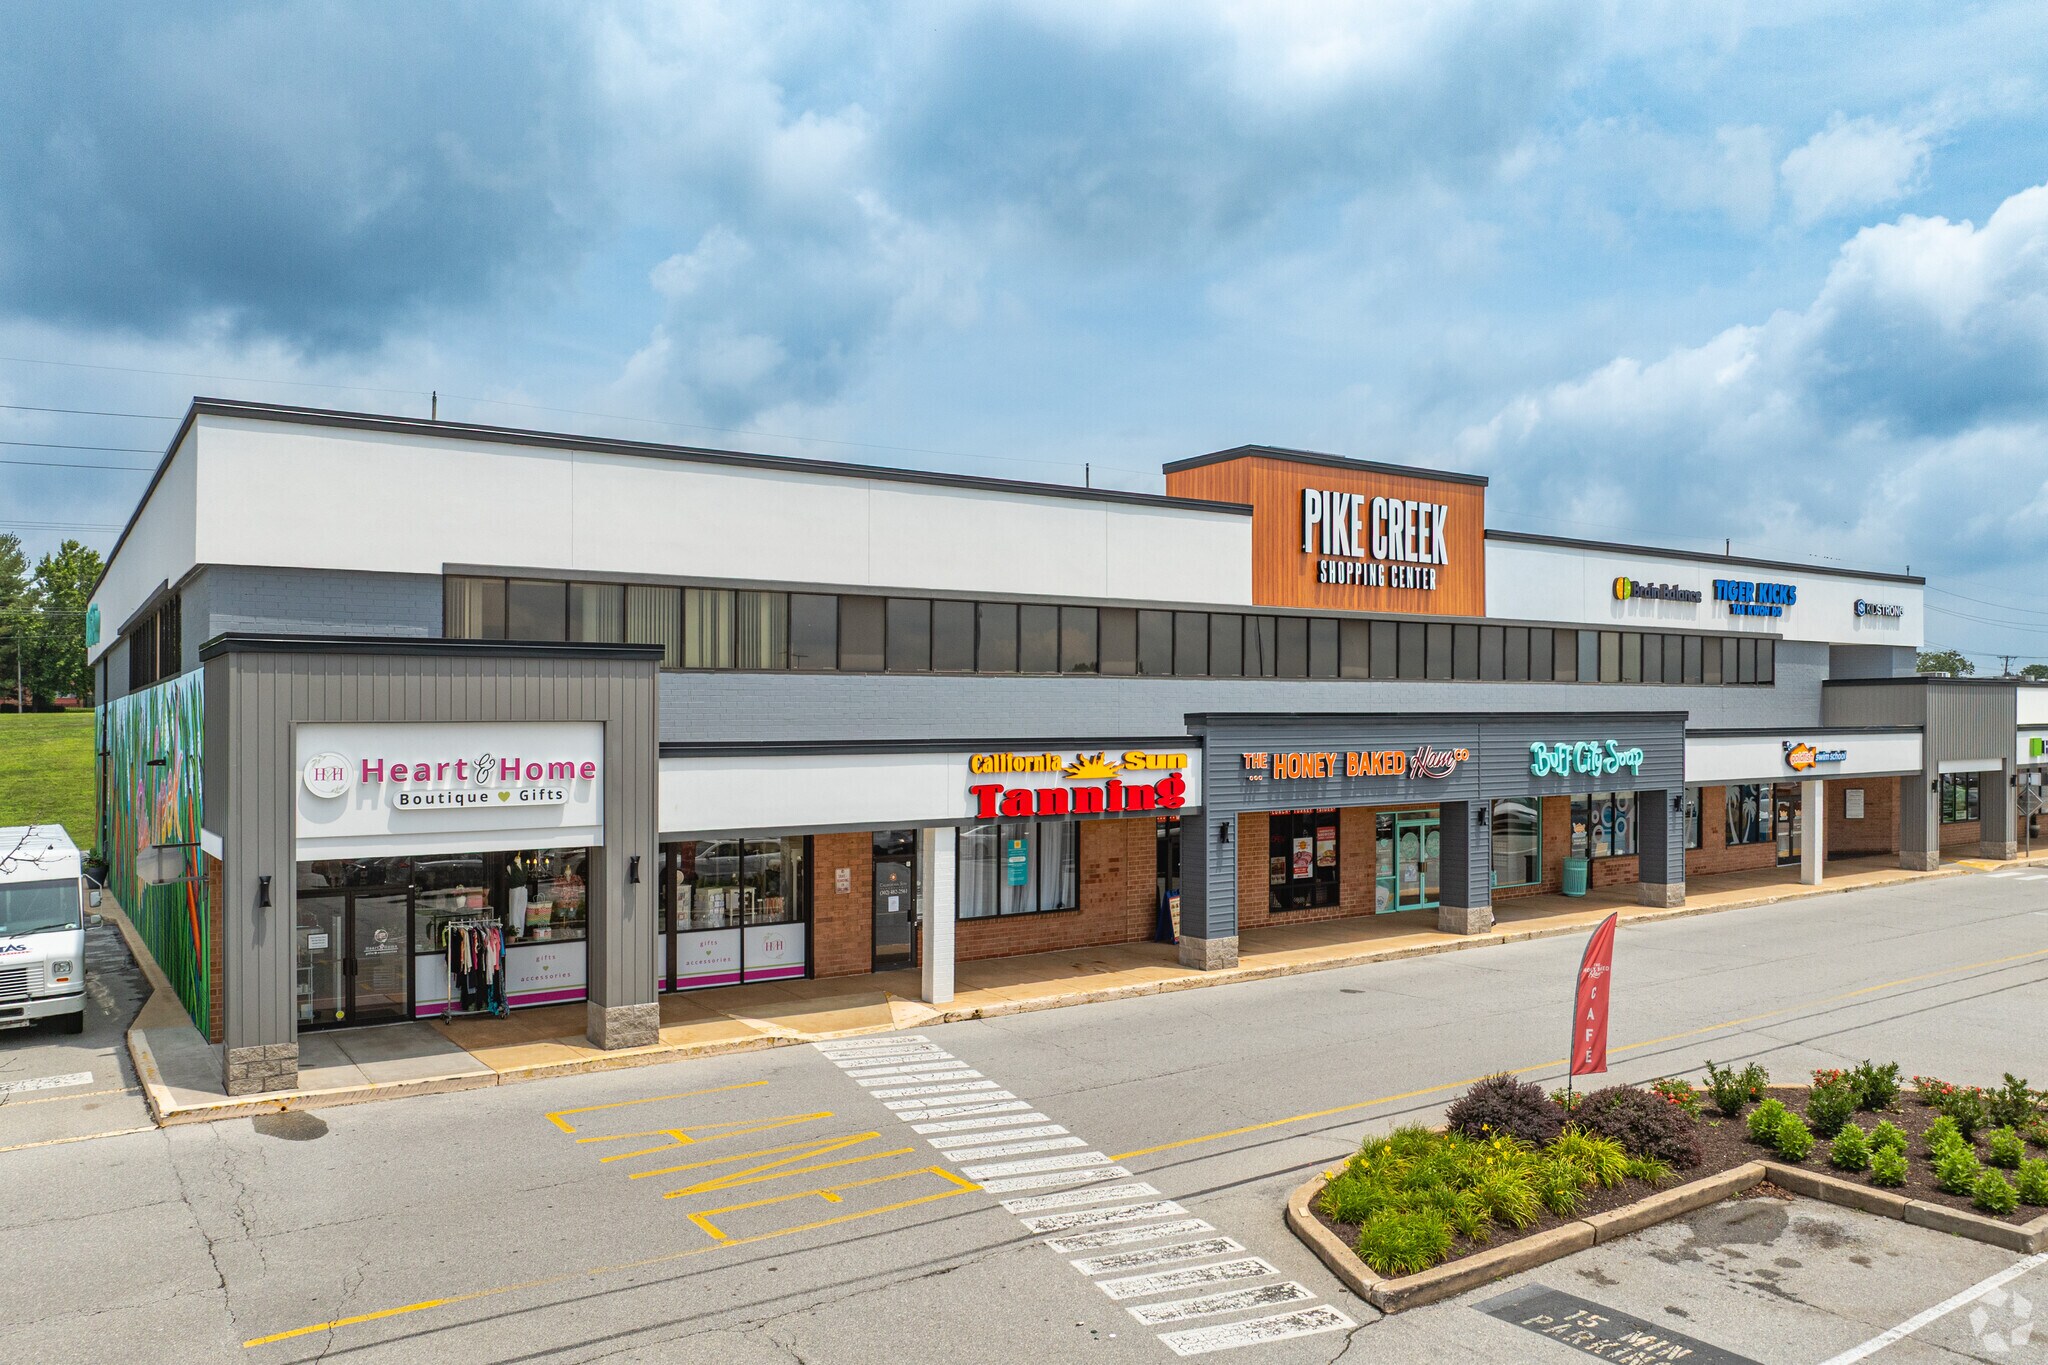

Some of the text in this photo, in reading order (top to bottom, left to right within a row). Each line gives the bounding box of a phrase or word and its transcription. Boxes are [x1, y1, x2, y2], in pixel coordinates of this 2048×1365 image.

[1302, 488, 1448, 565] PIKE CREEK
[1318, 559, 1436, 590] SHOPPING CENTER
[1631, 580, 1702, 603] Brain Balance
[1713, 579, 1797, 606] TIGER KICKS
[1730, 604, 1745, 615] TAE
[1771, 606, 1783, 617] DO
[1865, 603, 1904, 617] KIDSTRONG
[361, 753, 597, 784] Heart & Home
[970, 751, 1188, 775] California Sun
[1243, 752, 1268, 769] THE
[1273, 752, 1337, 779] HONEY
[1346, 751, 1406, 776] BAKED
[1410, 745, 1457, 780] Ham
[1790, 750, 1846, 766] goldfish swim school
[399, 788, 563, 807] Boutique Gifts
[970, 772, 1186, 819] Tanning
[700, 940, 718, 948] gifts
[535, 954, 556, 963] gifts
[686, 957, 731, 966] accessories
[520, 972, 571, 982] accessories
[1585, 986, 1597, 1063] CAFÉ
[1521, 1314, 1672, 1365] PARKIN
[1563, 1309, 1693, 1360] 15 MIN
